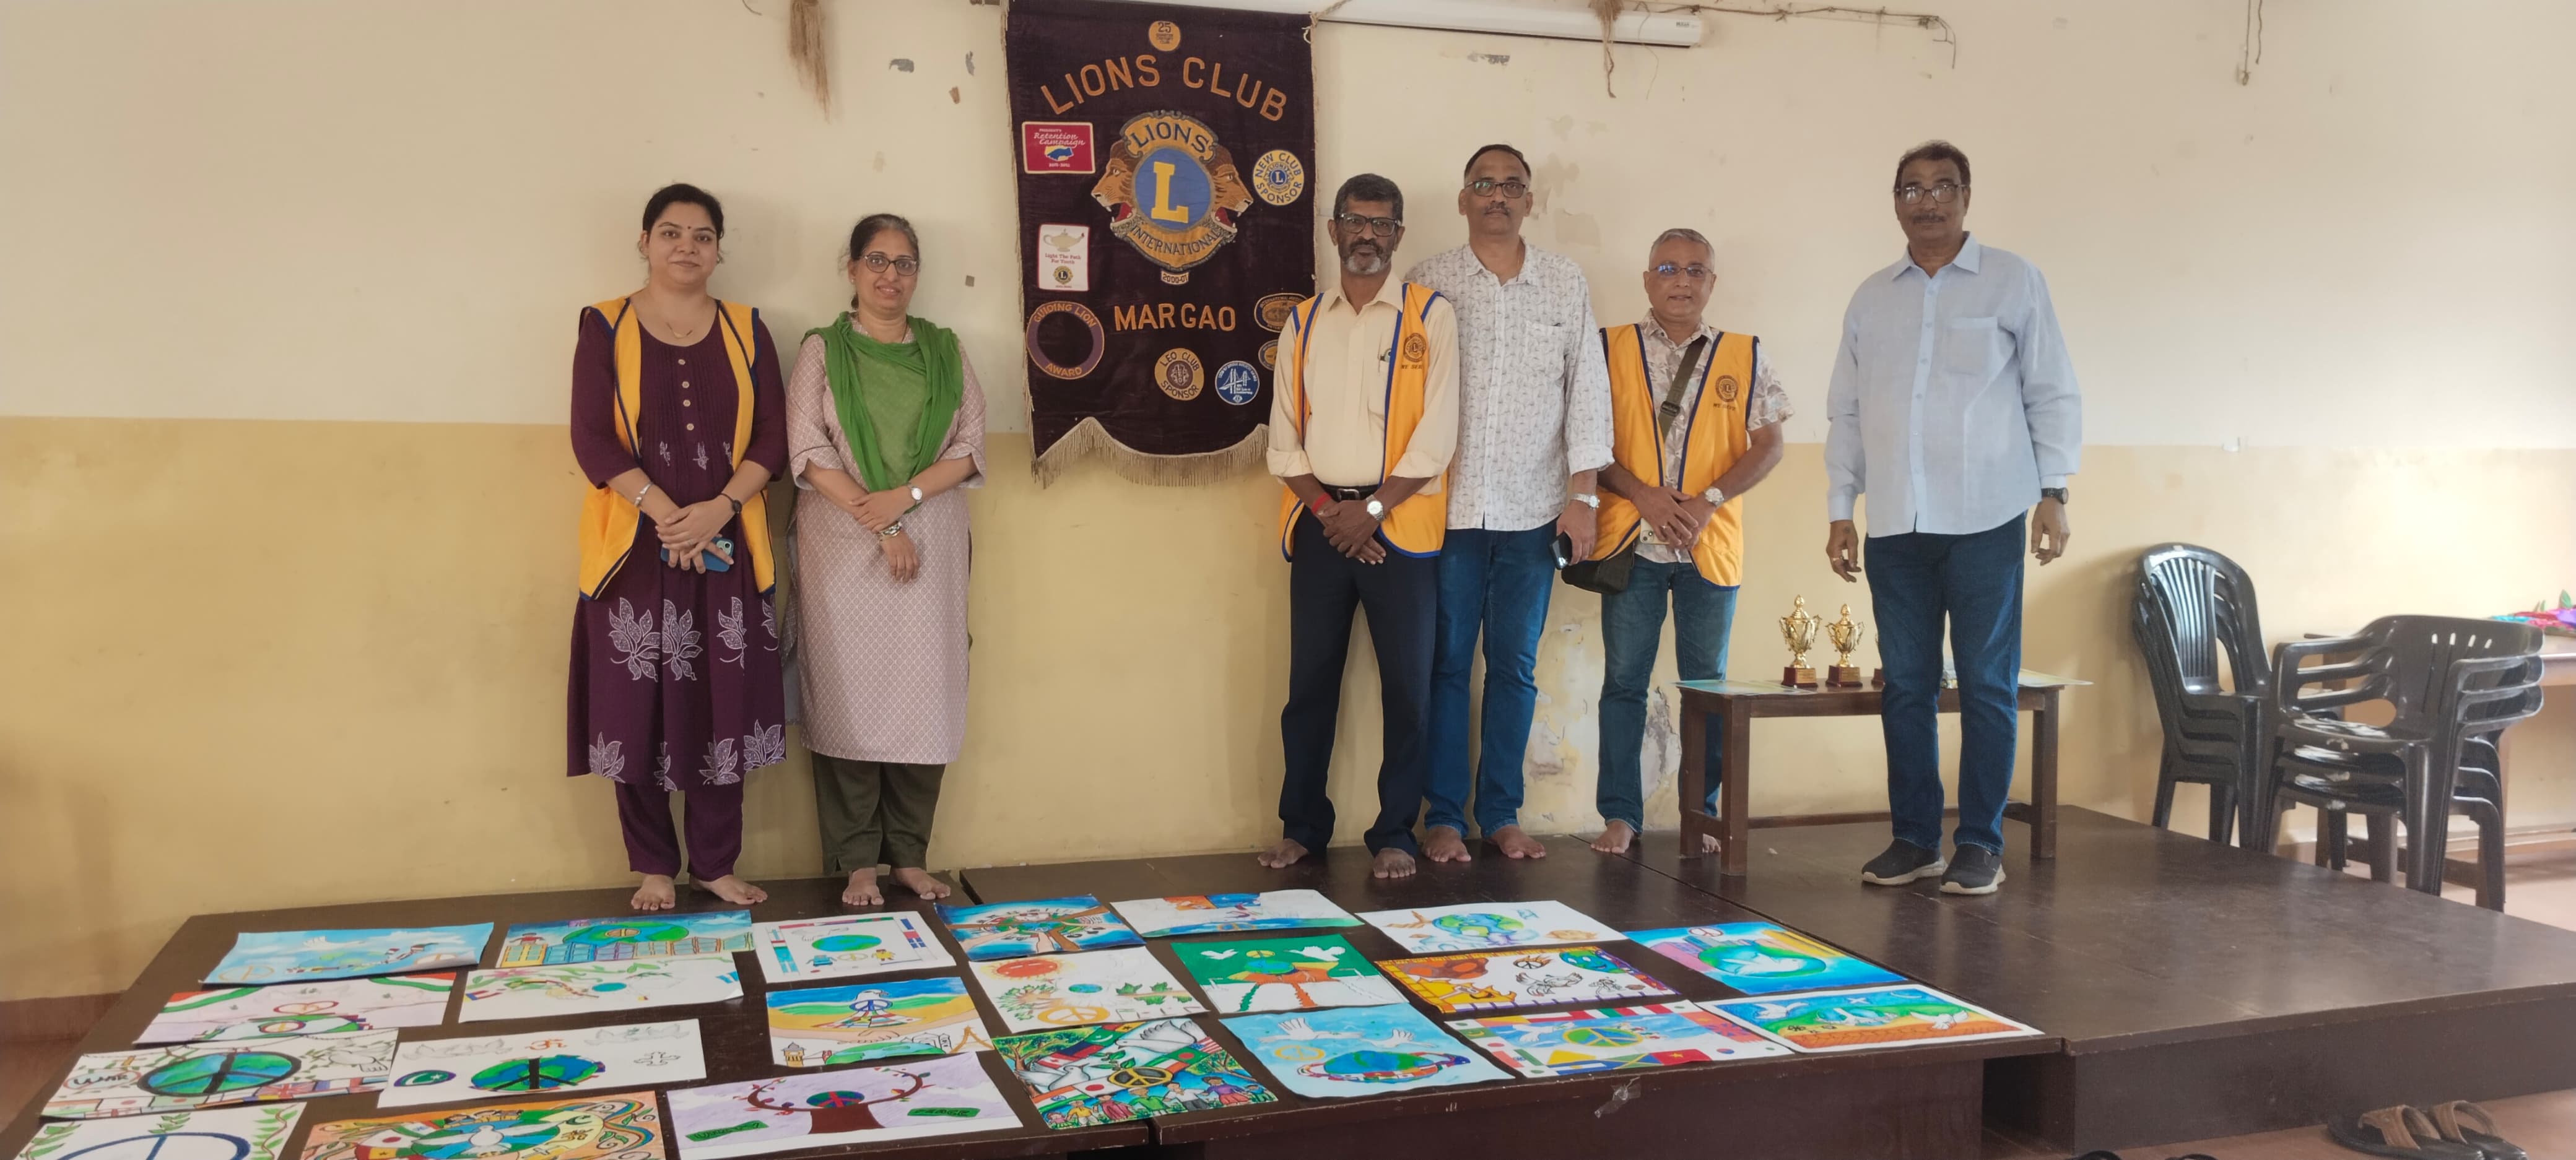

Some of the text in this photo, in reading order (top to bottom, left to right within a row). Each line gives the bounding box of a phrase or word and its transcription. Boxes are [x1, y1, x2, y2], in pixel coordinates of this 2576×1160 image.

[1158, 22, 1172, 33] 25
[1040, 54, 1287, 121] LIONS CLUB
[1040, 138, 1086, 149] Campaign
[1130, 122, 1209, 153] LIONS
[1255, 153, 1301, 178] NEW CLUB
[1276, 171, 1284, 183] L
[1151, 161, 1188, 223] L
[1256, 182, 1302, 203] SPONSOR
[1131, 225, 1222, 256] INTERNATIONAL
[1034, 303, 1097, 327] GUIDING LION
[1115, 303, 1236, 331] MARGAO
[1045, 363, 1082, 377] AWARD
[1160, 352, 1199, 371] LEO CLUB
[1161, 381, 1199, 398] SPONSOR
